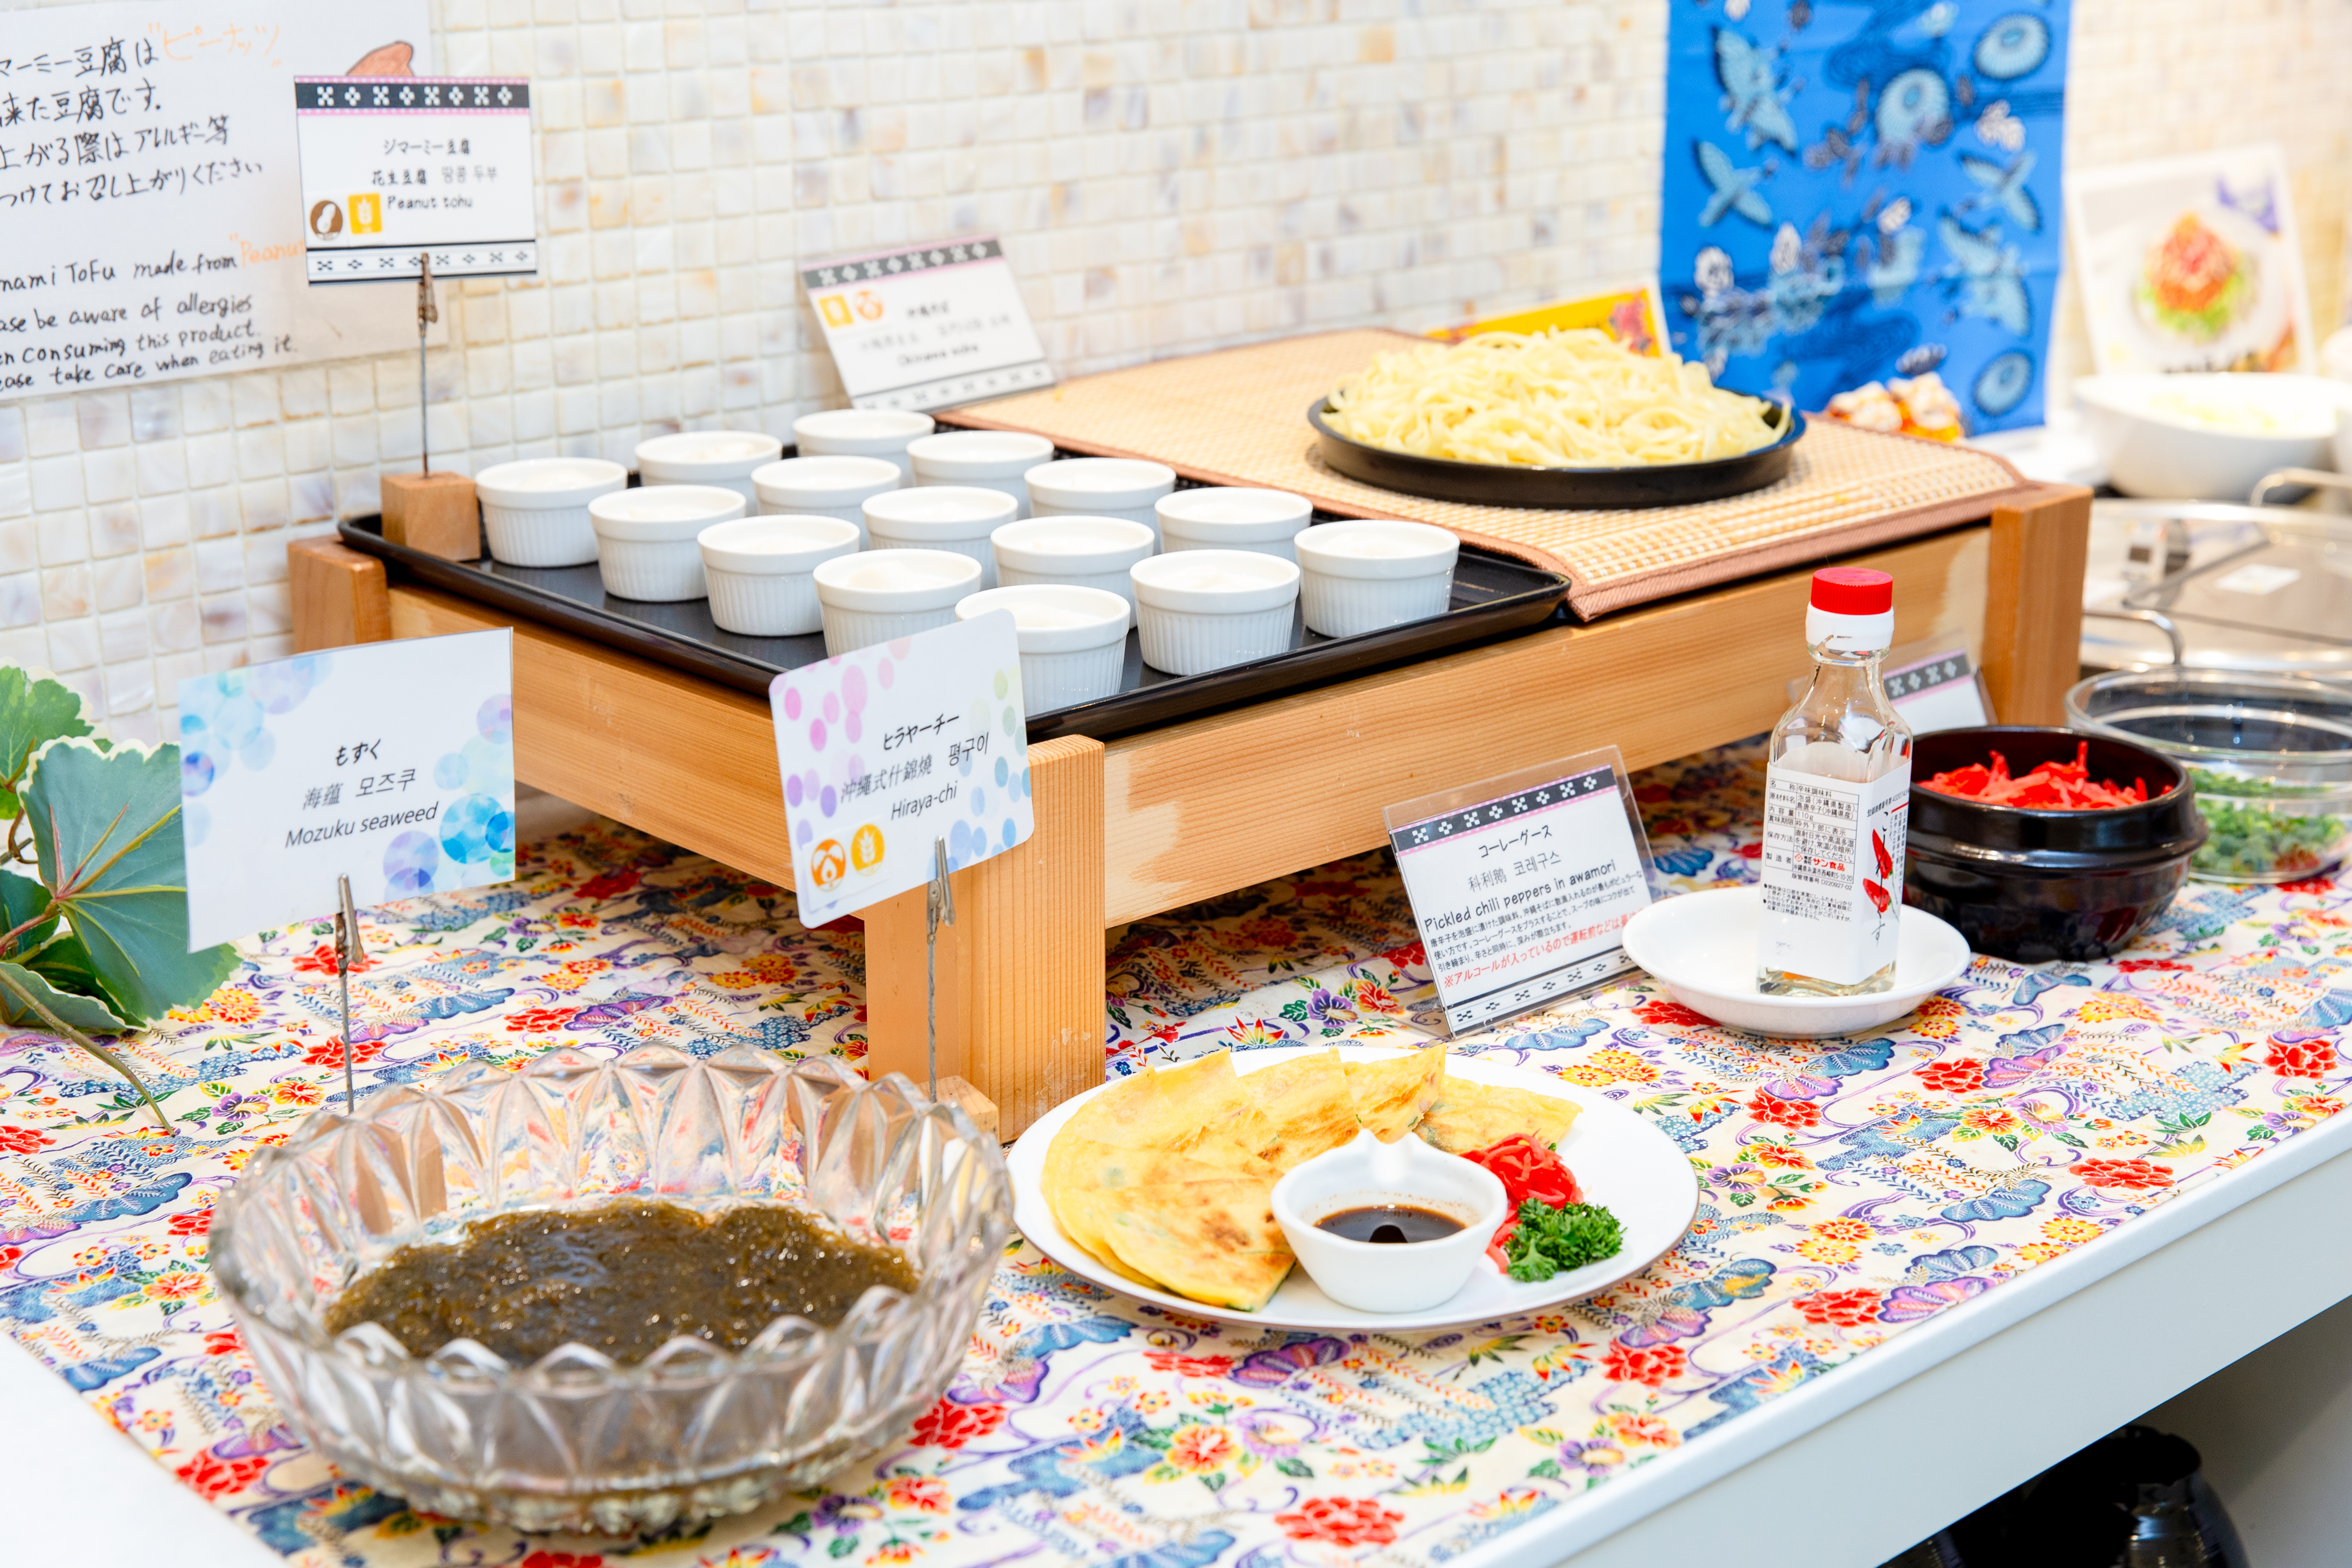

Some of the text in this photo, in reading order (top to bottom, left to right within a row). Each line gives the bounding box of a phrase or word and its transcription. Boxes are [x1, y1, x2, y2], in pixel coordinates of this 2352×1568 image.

[387, 195, 437, 210] Peanut
[133, 249, 187, 279] made
[191, 253, 237, 273] from
[33, 308, 57, 329] be
[69, 308, 127, 324] aware
[177, 292, 252, 318] allergies
[136, 332, 169, 351] this
[49, 364, 94, 385] take
[155, 354, 199, 372] when
[208, 342, 264, 365] eating
[883, 713, 960, 750] ヒラヤーチー
[335, 738, 381, 766] もずく
[949, 732, 989, 766] 평구이
[355, 768, 416, 797] 모즈쿠
[1798, 784, 1832, 798] 辛味調味料
[891, 780, 958, 820] Hiraya-chi
[1770, 792, 1795, 804] 原材料名
[285, 800, 439, 849] Mozuku seaweed
[1769, 815, 1794, 826] 賞味期限
[1795, 820, 1846, 836] 枠外下部に表示
[1479, 825, 1552, 858] コーレーグース
[1767, 831, 1793, 843] 保存方法
[1513, 851, 1561, 876] 코레구스
[1795, 845, 1852, 863] で保存してください。
[1813, 858, 1845, 871] サン食品
[1424, 859, 1616, 933] Pickled chili peppers in awamori
